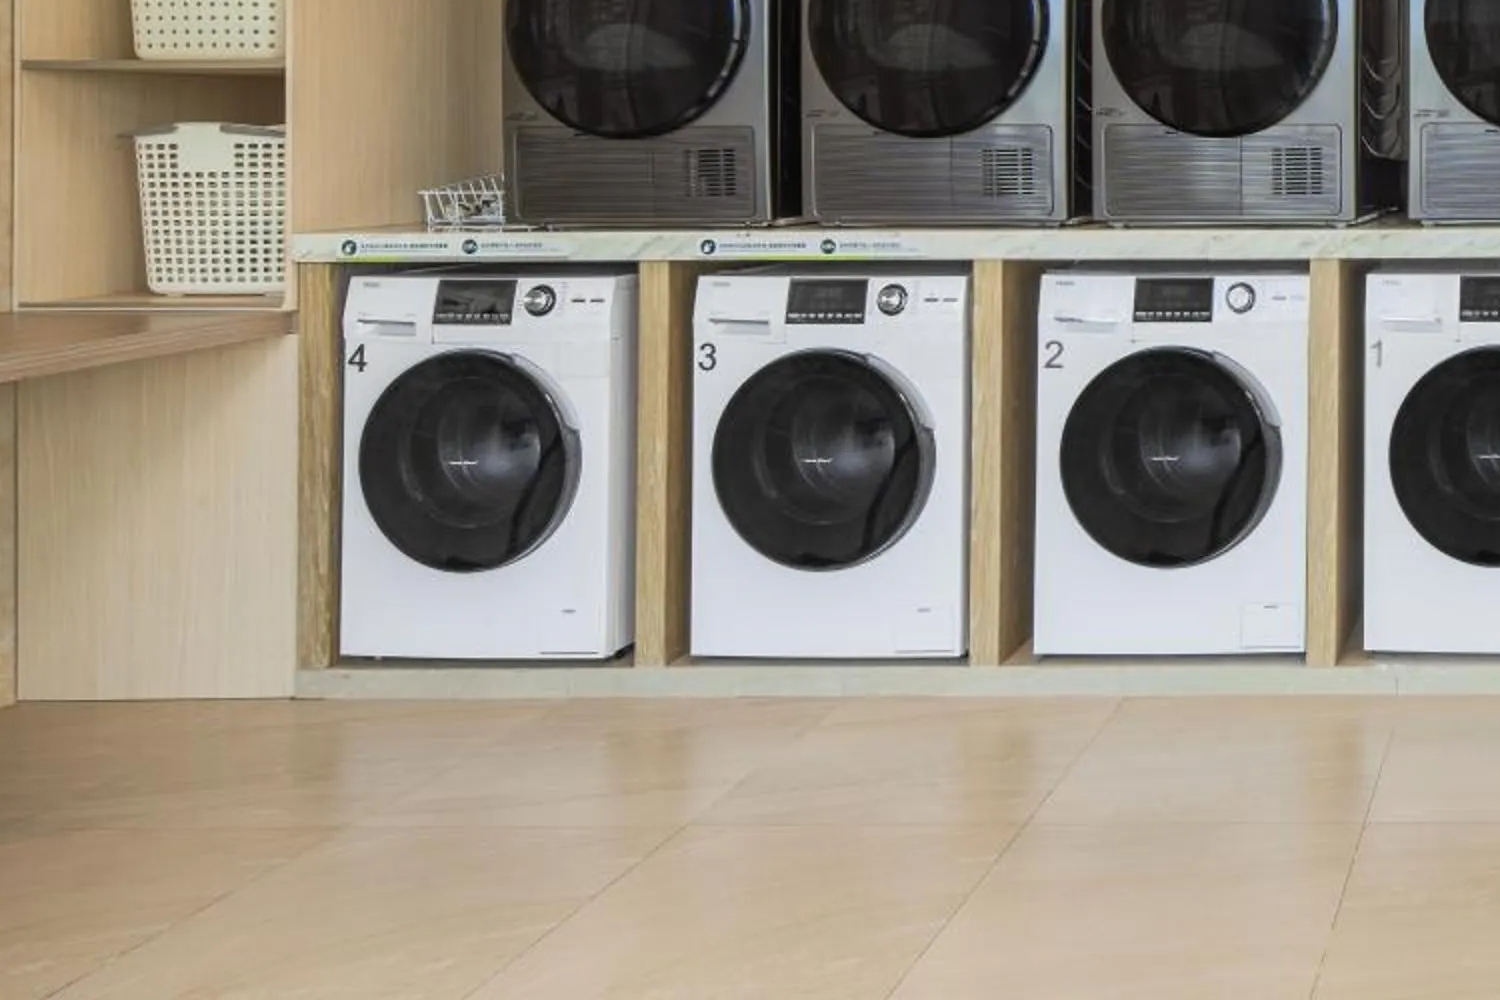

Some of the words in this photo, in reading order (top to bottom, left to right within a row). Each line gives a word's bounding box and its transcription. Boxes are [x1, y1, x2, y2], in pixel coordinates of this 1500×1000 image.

[348, 343, 368, 372] 4
[698, 343, 717, 371] 3
[1044, 341, 1064, 369] 2
[1369, 339, 1382, 368] 1
